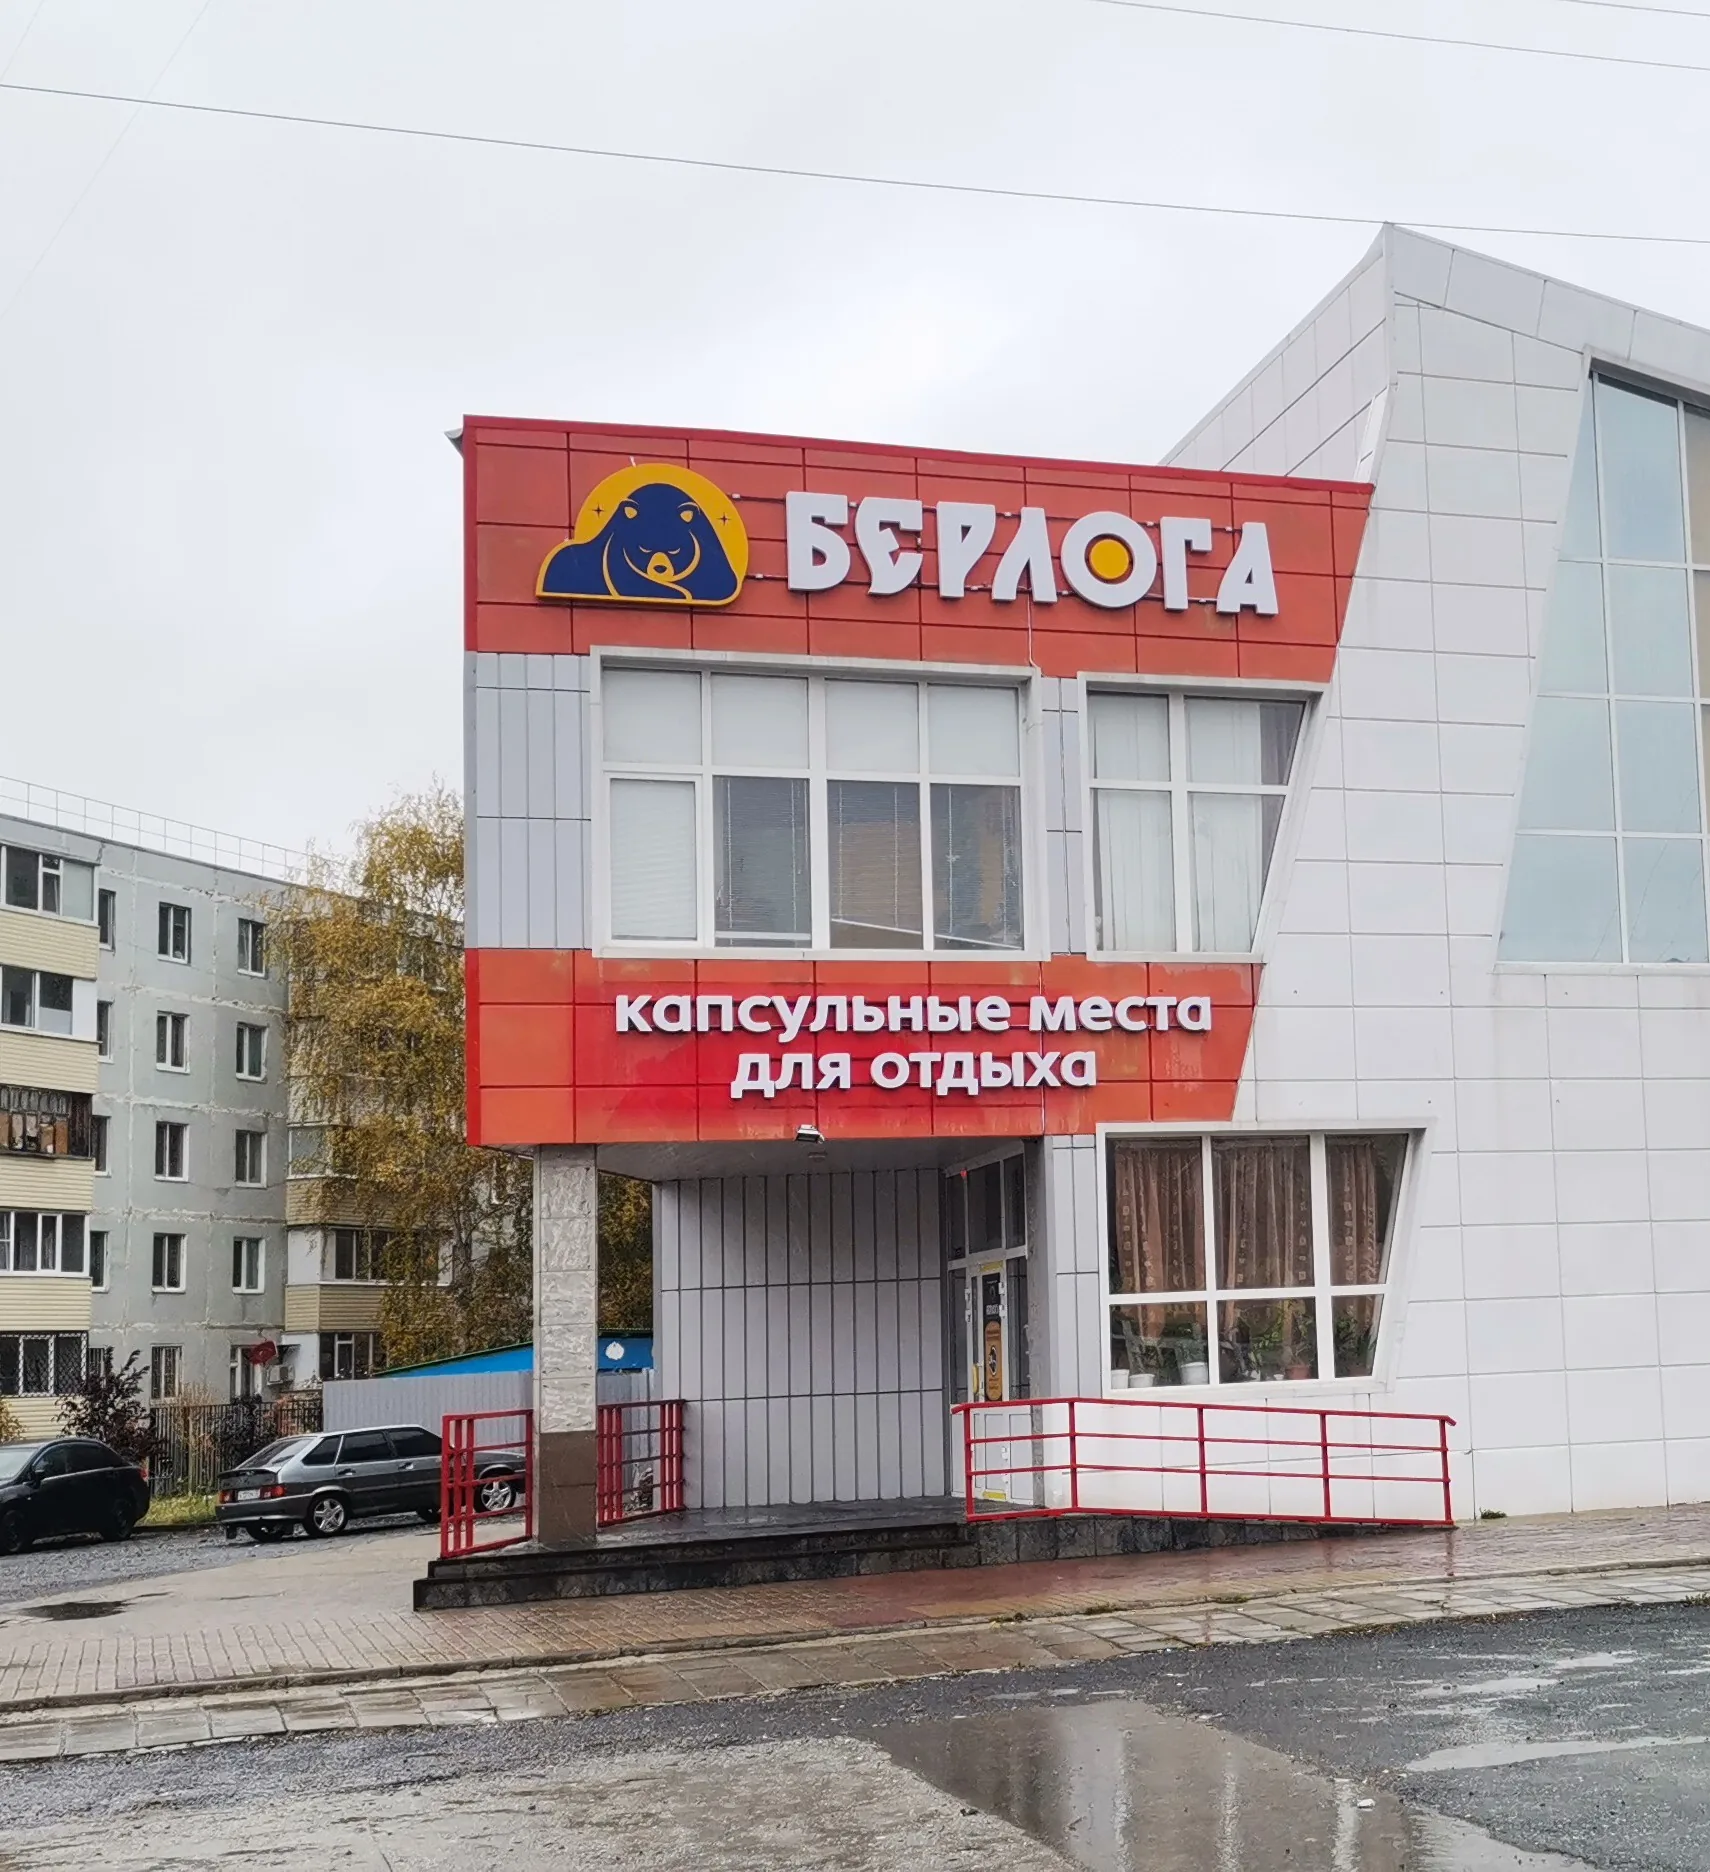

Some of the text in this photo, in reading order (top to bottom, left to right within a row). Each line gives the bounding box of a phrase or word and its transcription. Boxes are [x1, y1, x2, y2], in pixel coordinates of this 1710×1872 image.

[786, 491, 1279, 615] БЕРЛОГА
[615, 994, 1212, 1043] капсульные места
[731, 1050, 1097, 1099] для отдыха
